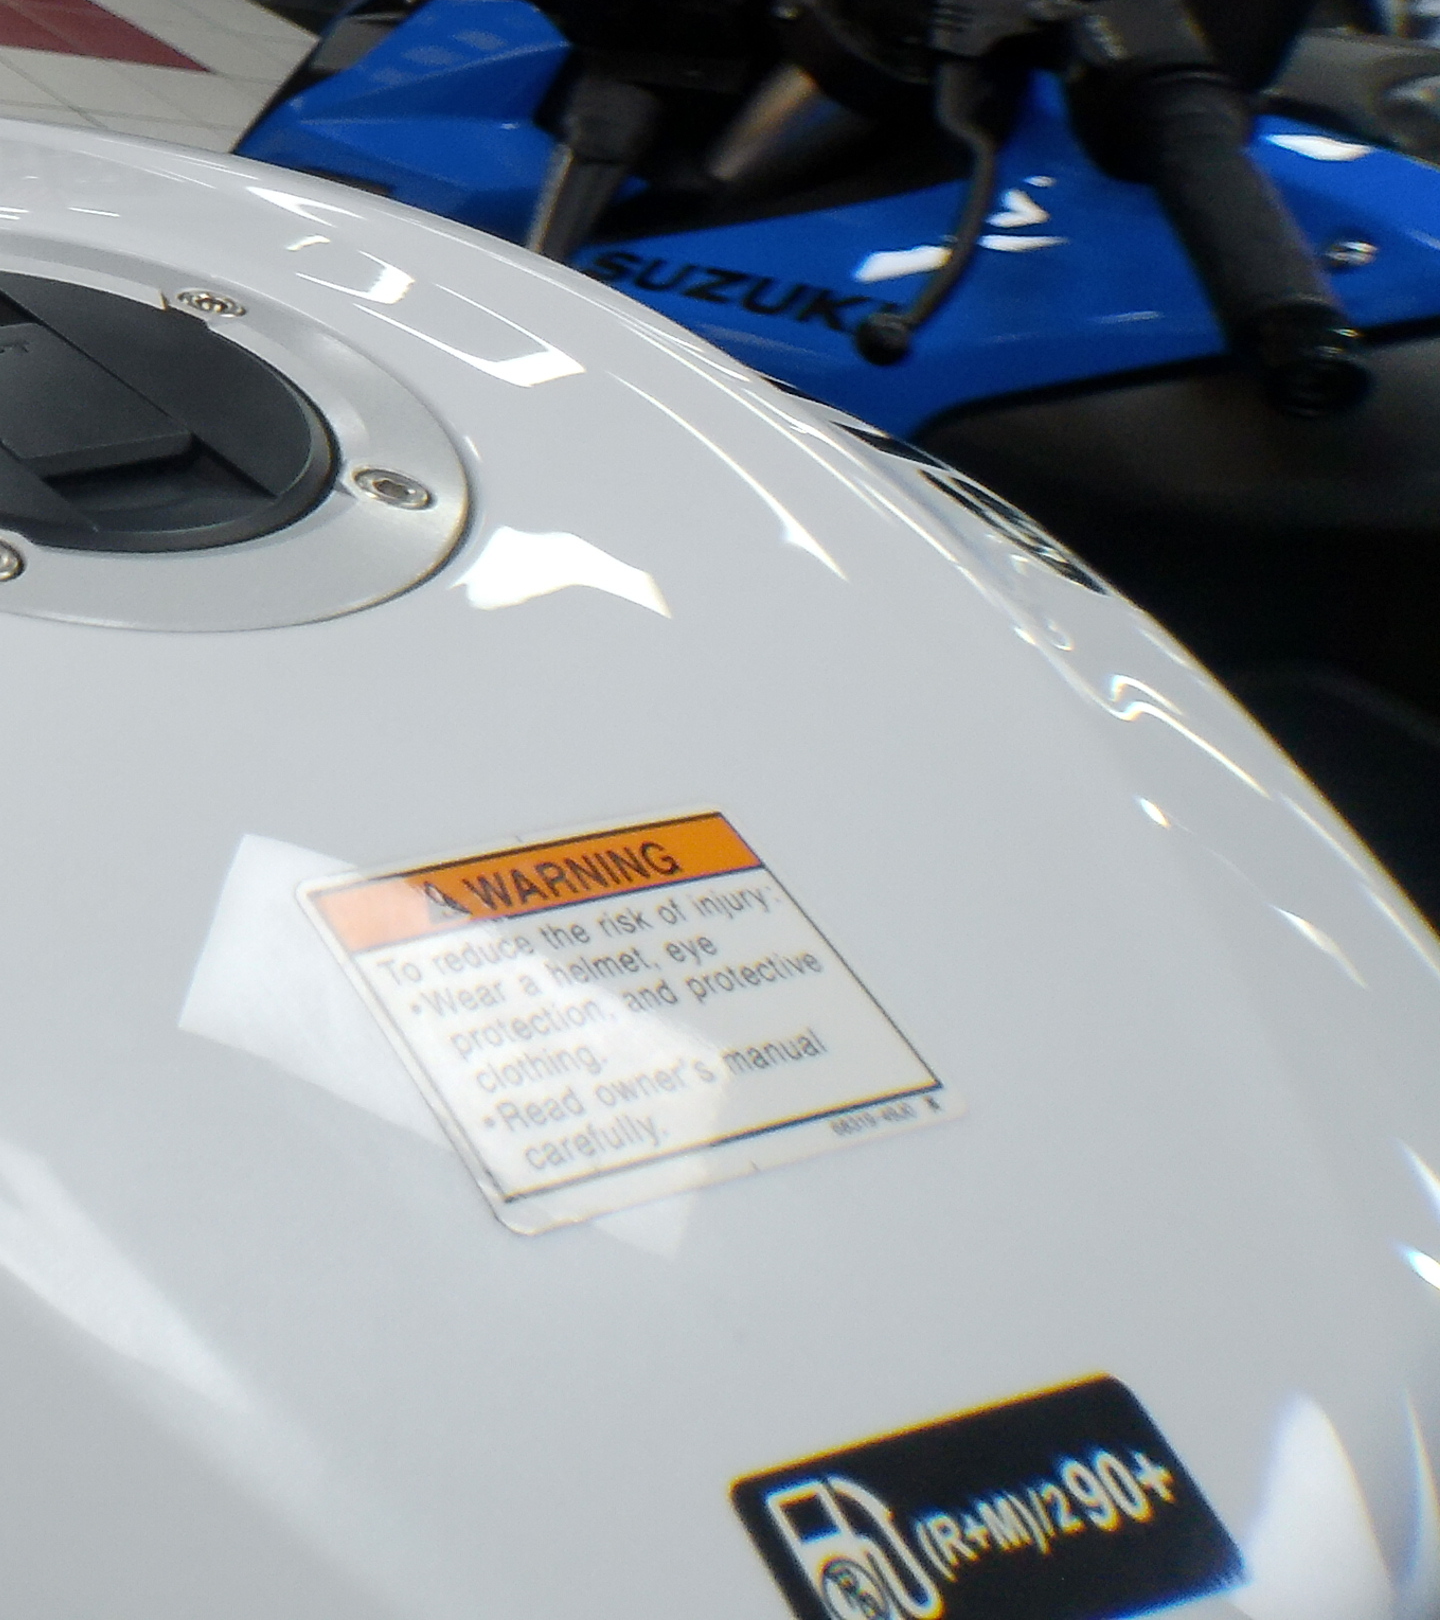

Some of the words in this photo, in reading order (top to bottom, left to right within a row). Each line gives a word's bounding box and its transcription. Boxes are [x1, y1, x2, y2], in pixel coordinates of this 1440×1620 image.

[462, 840, 682, 911] WARNING
[376, 957, 423, 986] To
[431, 933, 536, 975] reduce
[538, 923, 590, 949] the
[597, 907, 652, 936] risk
[655, 897, 689, 926] of
[689, 883, 783, 921] injury:
[517, 974, 542, 997] a
[544, 946, 661, 985] helmet,
[664, 935, 718, 965] eye
[450, 999, 614, 1056] protection,
[622, 979, 679, 1010] and
[684, 949, 824, 1003] protective
[475, 1044, 606, 1093] clothing.
[595, 1058, 716, 1107] owner's
[722, 1026, 828, 1074] manual
[524, 1115, 667, 1171] carefully.
